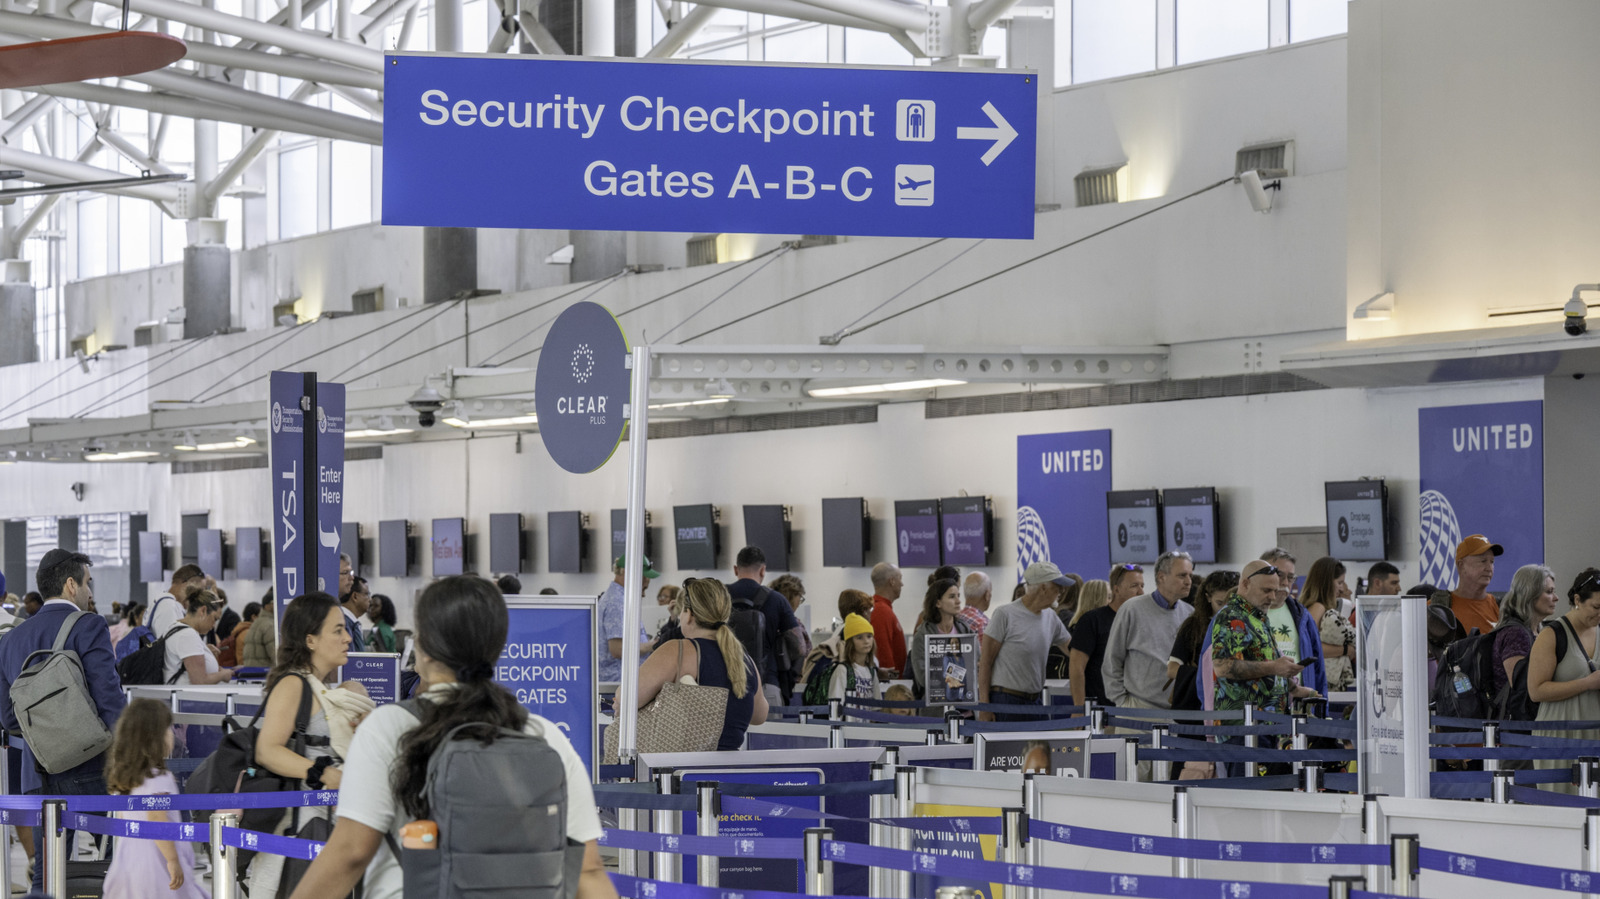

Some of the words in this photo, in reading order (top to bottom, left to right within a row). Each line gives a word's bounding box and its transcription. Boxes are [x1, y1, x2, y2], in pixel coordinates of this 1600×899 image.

[419, 89, 606, 139] Security
[619, 95, 875, 143] Checkpoint
[583, 159, 715, 199] Gates
[727, 163, 873, 202] A-B-C
[590, 416, 606, 425] PLUS
[1453, 423, 1533, 453] UNITED
[1042, 449, 1103, 474] UNITED
[320, 466, 341, 482] Enter
[321, 487, 340, 503] Here
[282, 460, 296, 552] TSA
[678, 526, 707, 540] FRONTIER
[500, 643, 567, 659] ECURITY
[930, 644, 960, 654] REAL
[961, 643, 972, 653] ID
[494, 666, 580, 681] ECKPOINT
[516, 688, 567, 704] GATES
[990, 757, 1006, 767] ARE
[1007, 756, 1024, 766] YOU
[730, 813, 752, 822] check
